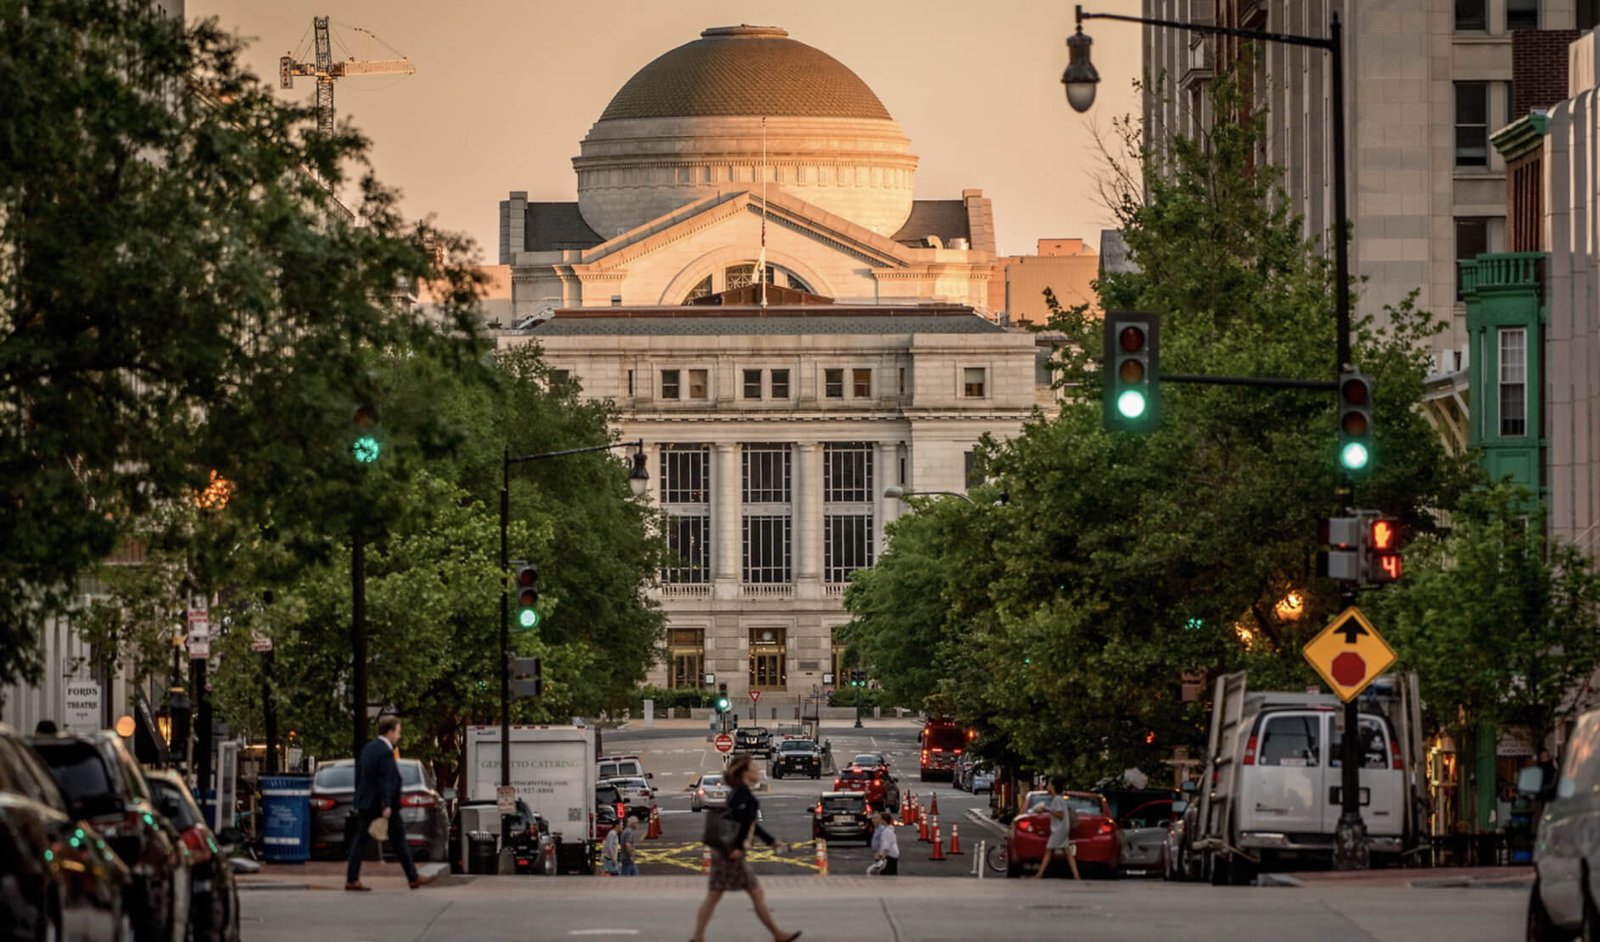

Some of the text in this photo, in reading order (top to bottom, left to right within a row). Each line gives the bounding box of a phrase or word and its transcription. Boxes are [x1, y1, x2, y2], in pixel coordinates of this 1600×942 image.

[1382, 556, 1397, 578] 4
[481, 760, 580, 769] GEPTTO CATERING
